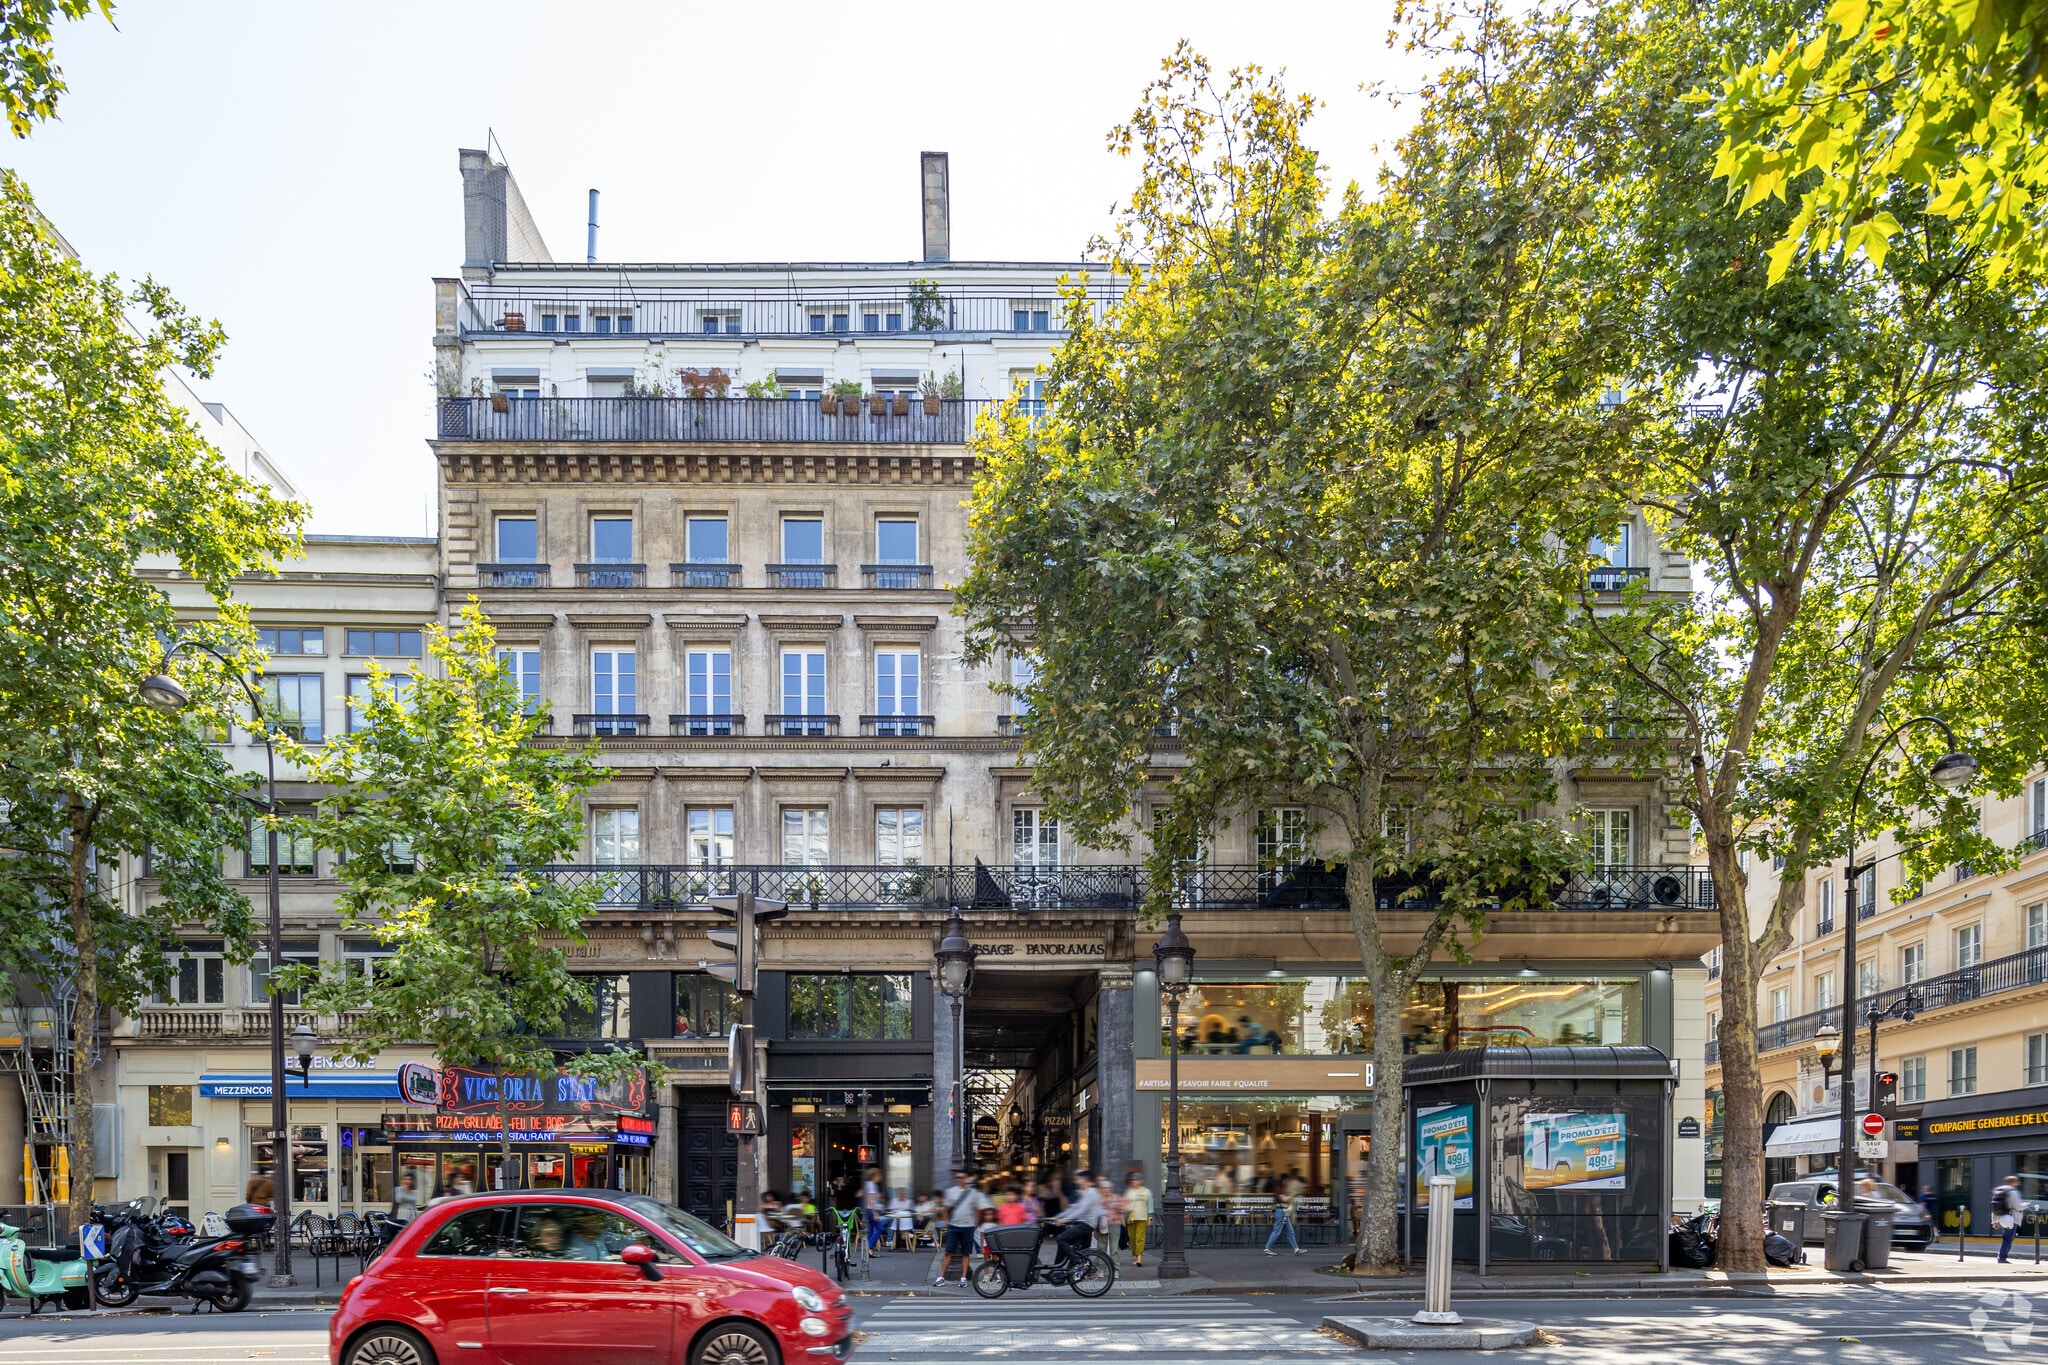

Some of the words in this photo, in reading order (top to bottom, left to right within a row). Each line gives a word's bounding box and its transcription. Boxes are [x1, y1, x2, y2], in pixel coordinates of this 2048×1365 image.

[975, 944, 1015, 956] SSAGE
[1026, 944, 1105, 956] PANORAMAS
[1233, 1078, 1269, 1087] #QUALITÉ
[214, 1086, 273, 1095] MEZZENCOR
[1423, 1124, 1447, 1135] PROMO
[1448, 1117, 1466, 1130] D'ÉTÉ
[1929, 1119, 1976, 1134] COMPAGNIE
[1978, 1115, 2021, 1129] GENERALE
[2022, 1113, 2034, 1125] DE
[453, 1132, 557, 1141] WAGON-RSTAURANT
[1560, 1129, 1593, 1140] PROMO
[1594, 1124, 1617, 1135] D'ÉTÉ
